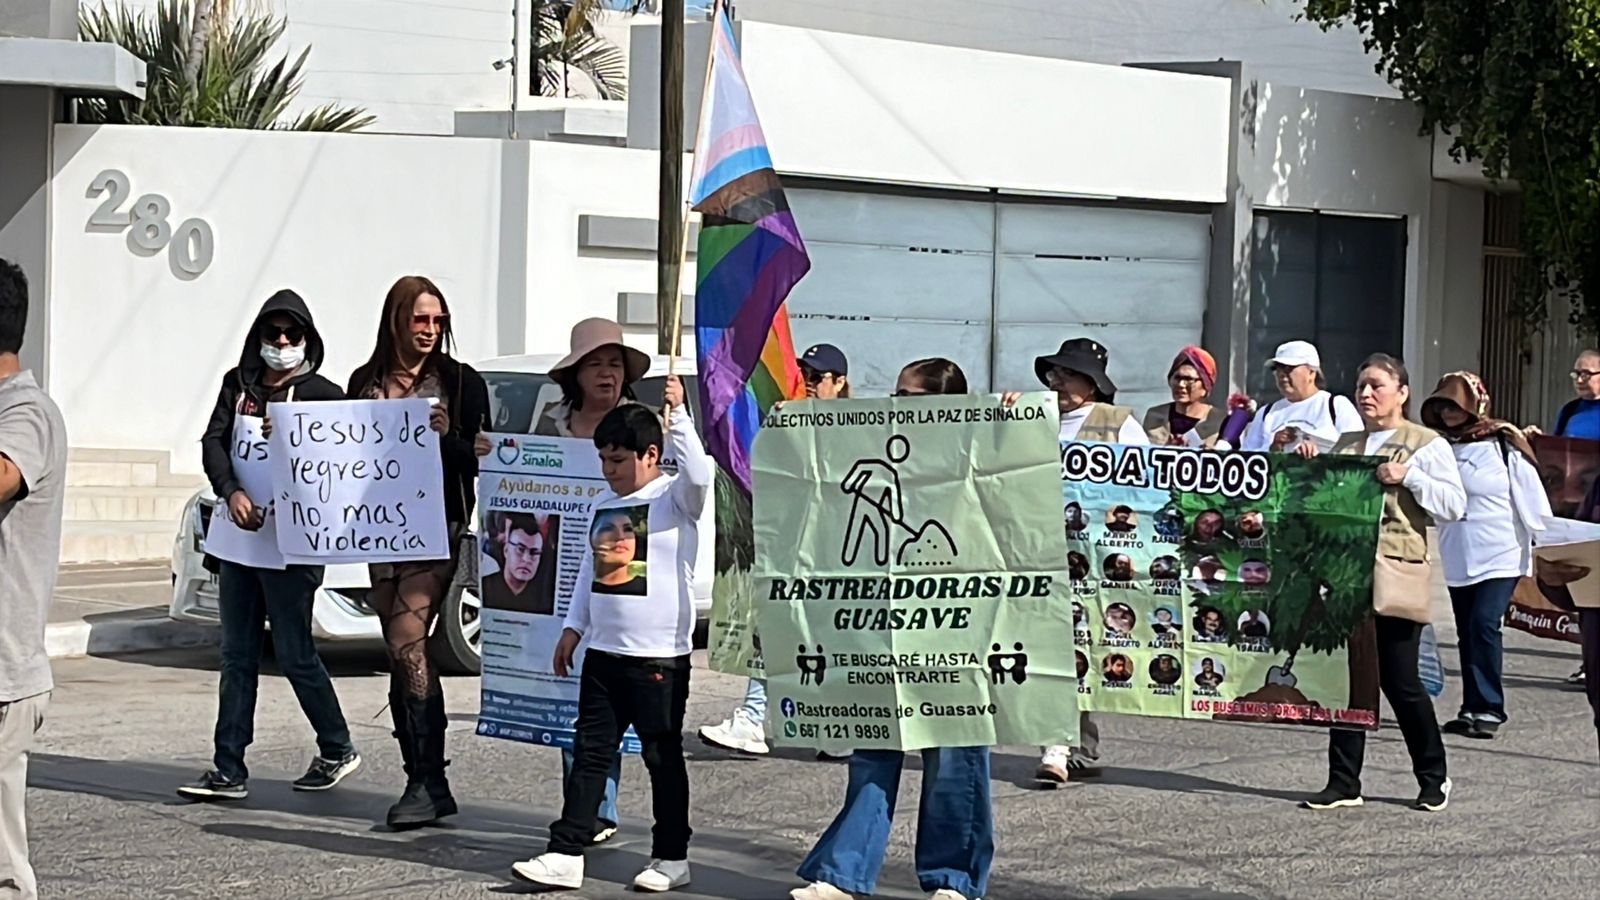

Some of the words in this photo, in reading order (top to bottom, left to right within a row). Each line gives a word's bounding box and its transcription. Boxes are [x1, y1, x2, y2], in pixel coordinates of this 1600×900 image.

[85, 169, 214, 281] 280
[837, 410, 885, 426] UNIDOS
[888, 410, 914, 425] POR
[918, 409, 935, 424] LA
[937, 408, 960, 423] PAZ
[964, 408, 981, 422] DE
[984, 405, 1046, 422] SINALOA
[290, 412, 384, 447] Jesus
[399, 411, 426, 447] de
[521, 453, 564, 468] Sinaloa
[289, 456, 401, 503] regreso
[1063, 444, 1113, 482] OS
[1117, 447, 1147, 486] A
[1152, 449, 1269, 499] TODOS
[574, 487, 583, 496] a
[490, 496, 518, 508] JESUS
[520, 499, 585, 513] GUADALUPE
[1095, 539, 1144, 549] ALBERTO
[769, 575, 1002, 601] RASTREADORAS
[1007, 575, 1053, 598] DE
[834, 606, 972, 631] GUASAVE
[832, 653, 849, 667] TE
[851, 651, 921, 667] BUSCARÉ
[925, 652, 979, 667] HASTA
[848, 670, 960, 685] ENCONTRARTE
[797, 702, 891, 718] Rastreadoras
[896, 703, 914, 719] de
[919, 702, 997, 717] Guasave
[1191, 700, 1210, 712] LOS
[824, 724, 850, 739] 121
[854, 724, 890, 739] 9898
